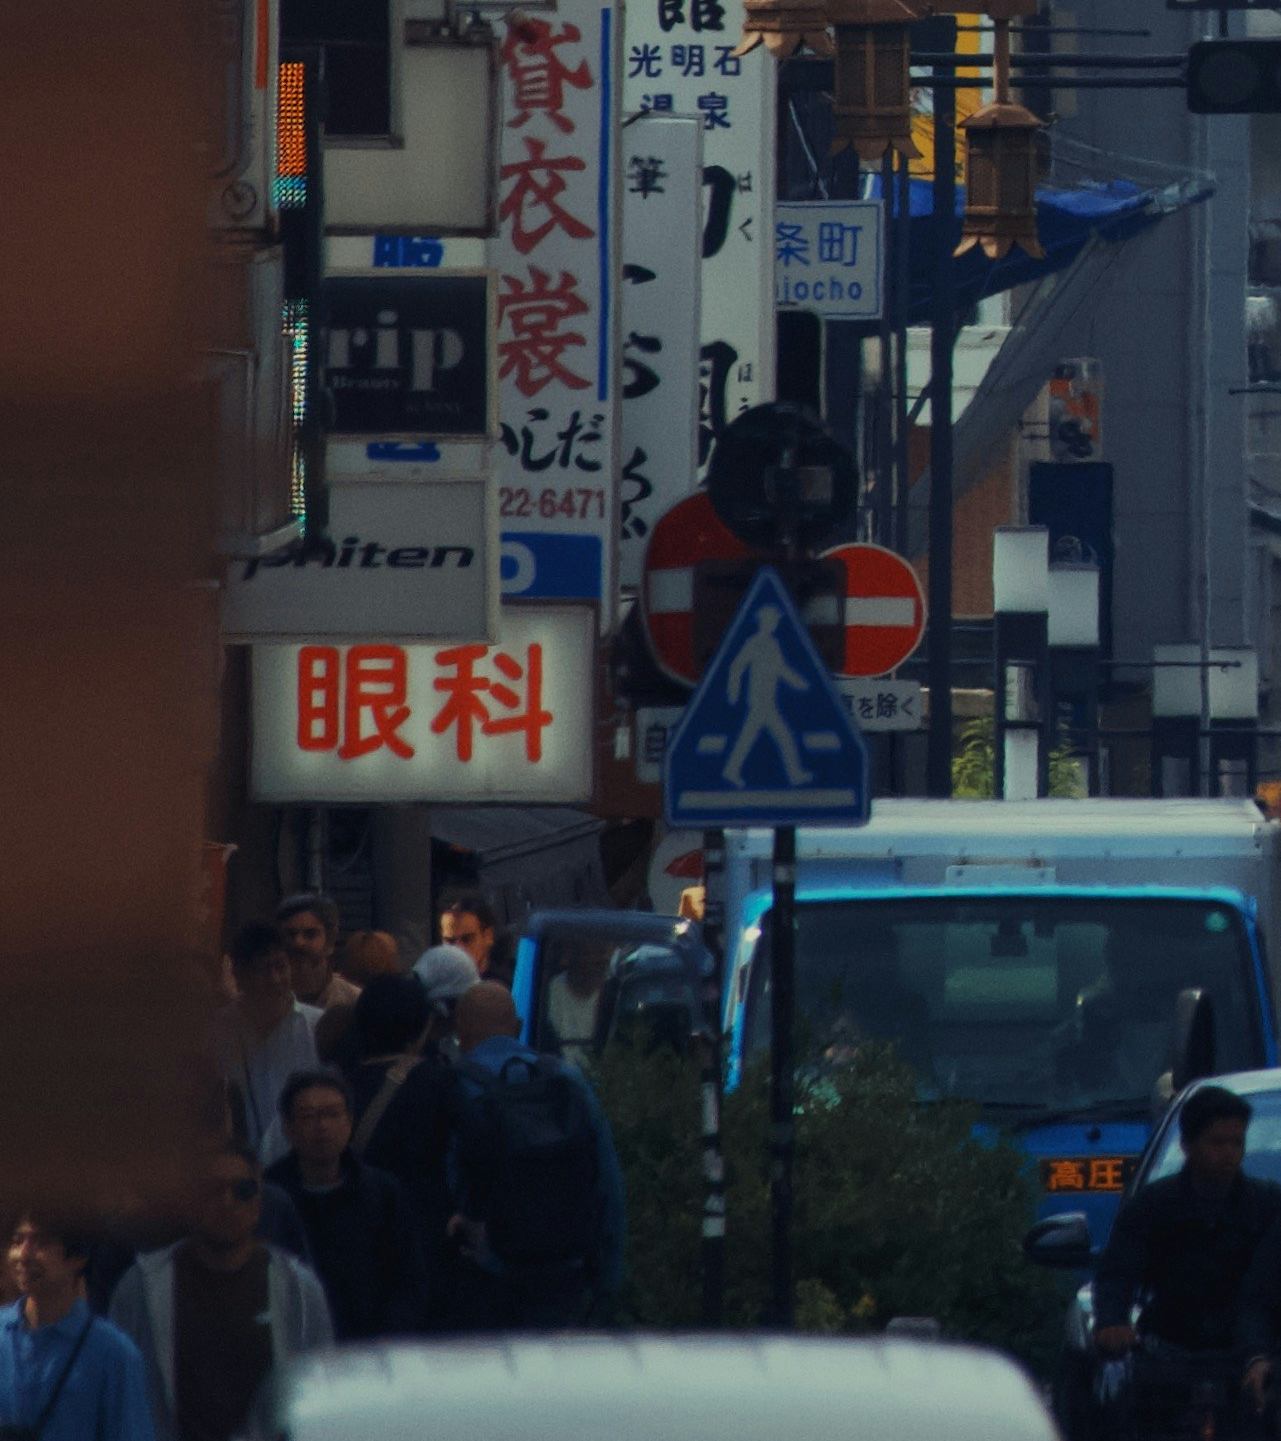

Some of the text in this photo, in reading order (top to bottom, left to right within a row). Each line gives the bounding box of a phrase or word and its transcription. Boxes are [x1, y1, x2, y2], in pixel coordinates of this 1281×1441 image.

[629, 43, 742, 78] 光明石
[628, 154, 669, 200] 筆
[498, 17, 597, 399] 貸衣裳
[297, 642, 554, 762] 眼科
[1047, 1159, 1136, 1192] 高圧
